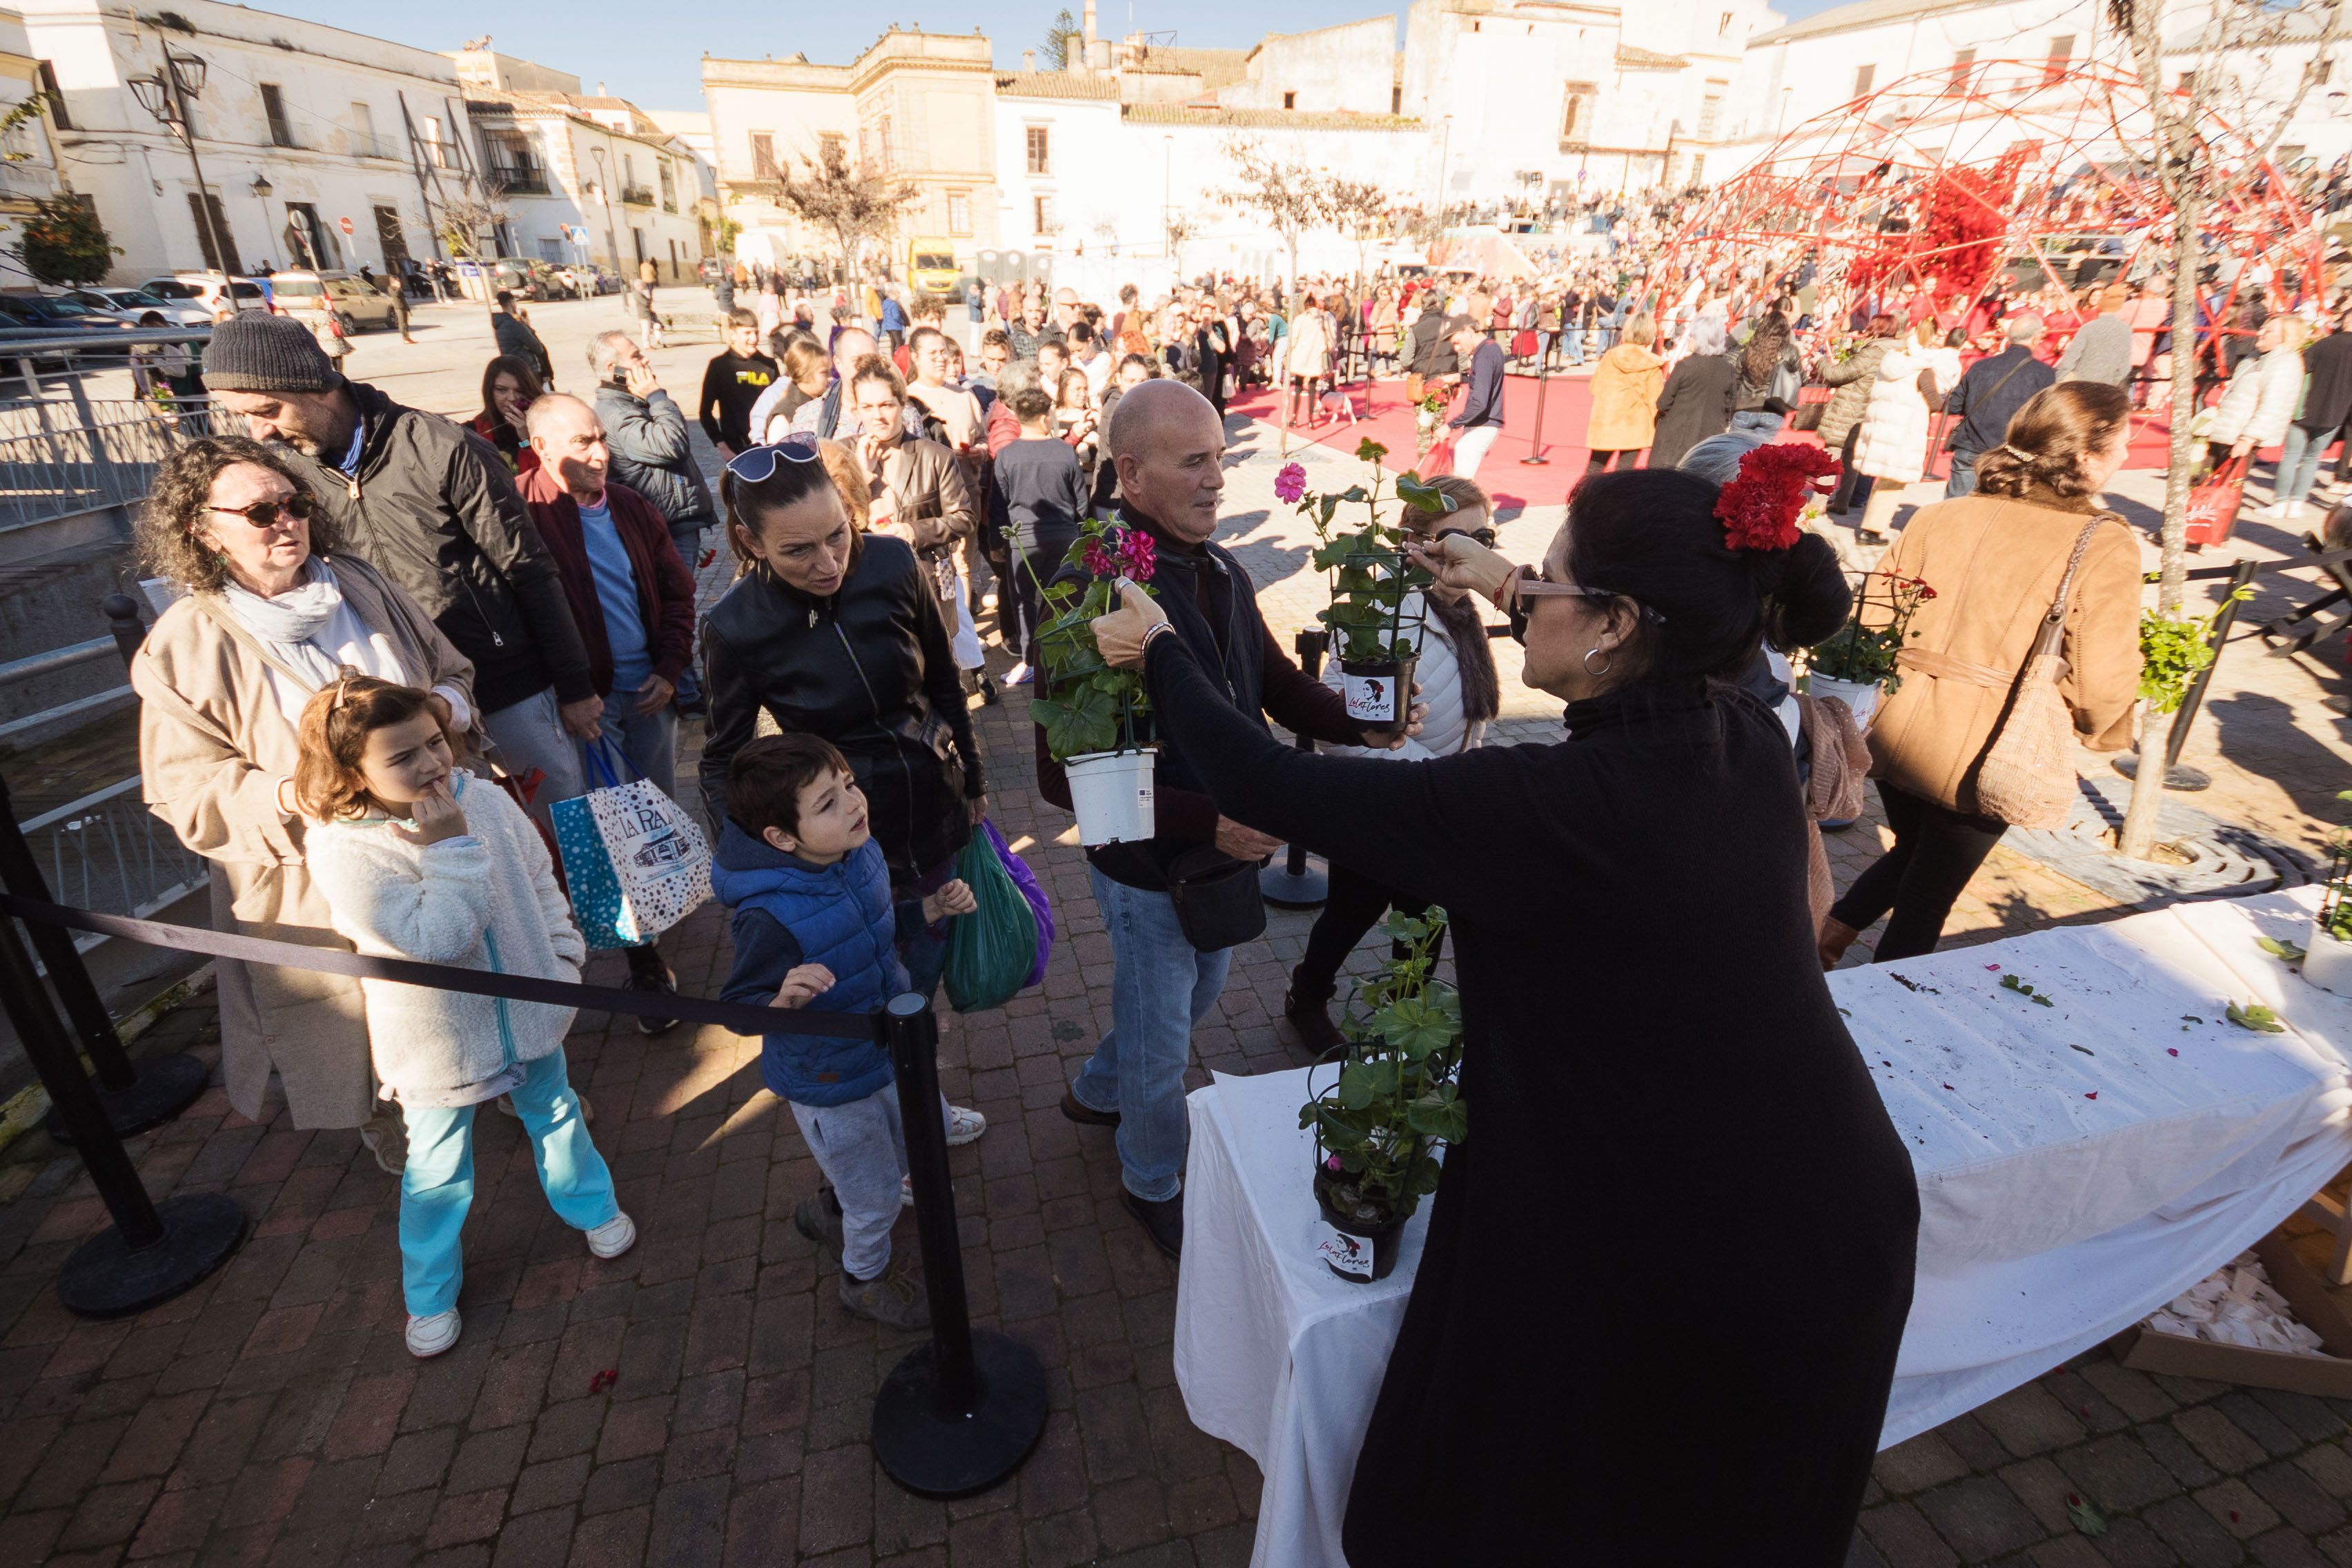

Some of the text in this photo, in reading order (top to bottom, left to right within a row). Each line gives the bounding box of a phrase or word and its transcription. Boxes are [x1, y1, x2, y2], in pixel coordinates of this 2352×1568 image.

[736, 371, 770, 385] FILA
[1360, 701, 1390, 712] Flores
[618, 816, 640, 839] LA
